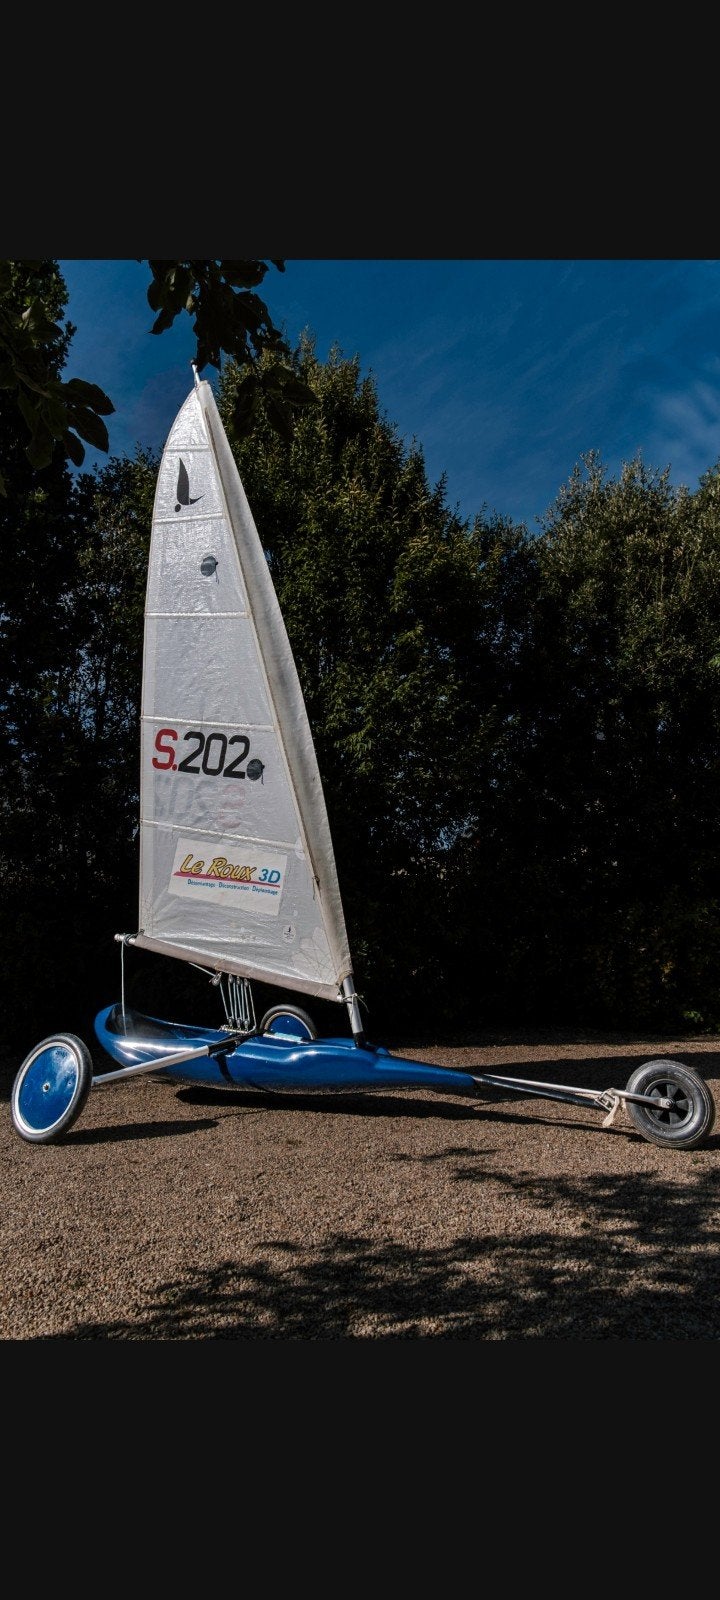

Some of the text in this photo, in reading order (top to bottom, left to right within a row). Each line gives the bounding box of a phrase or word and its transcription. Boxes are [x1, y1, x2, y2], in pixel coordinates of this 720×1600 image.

[151, 728, 251, 780] S.202
[179, 853, 205, 874] Le
[258, 868, 281, 884] 3D
